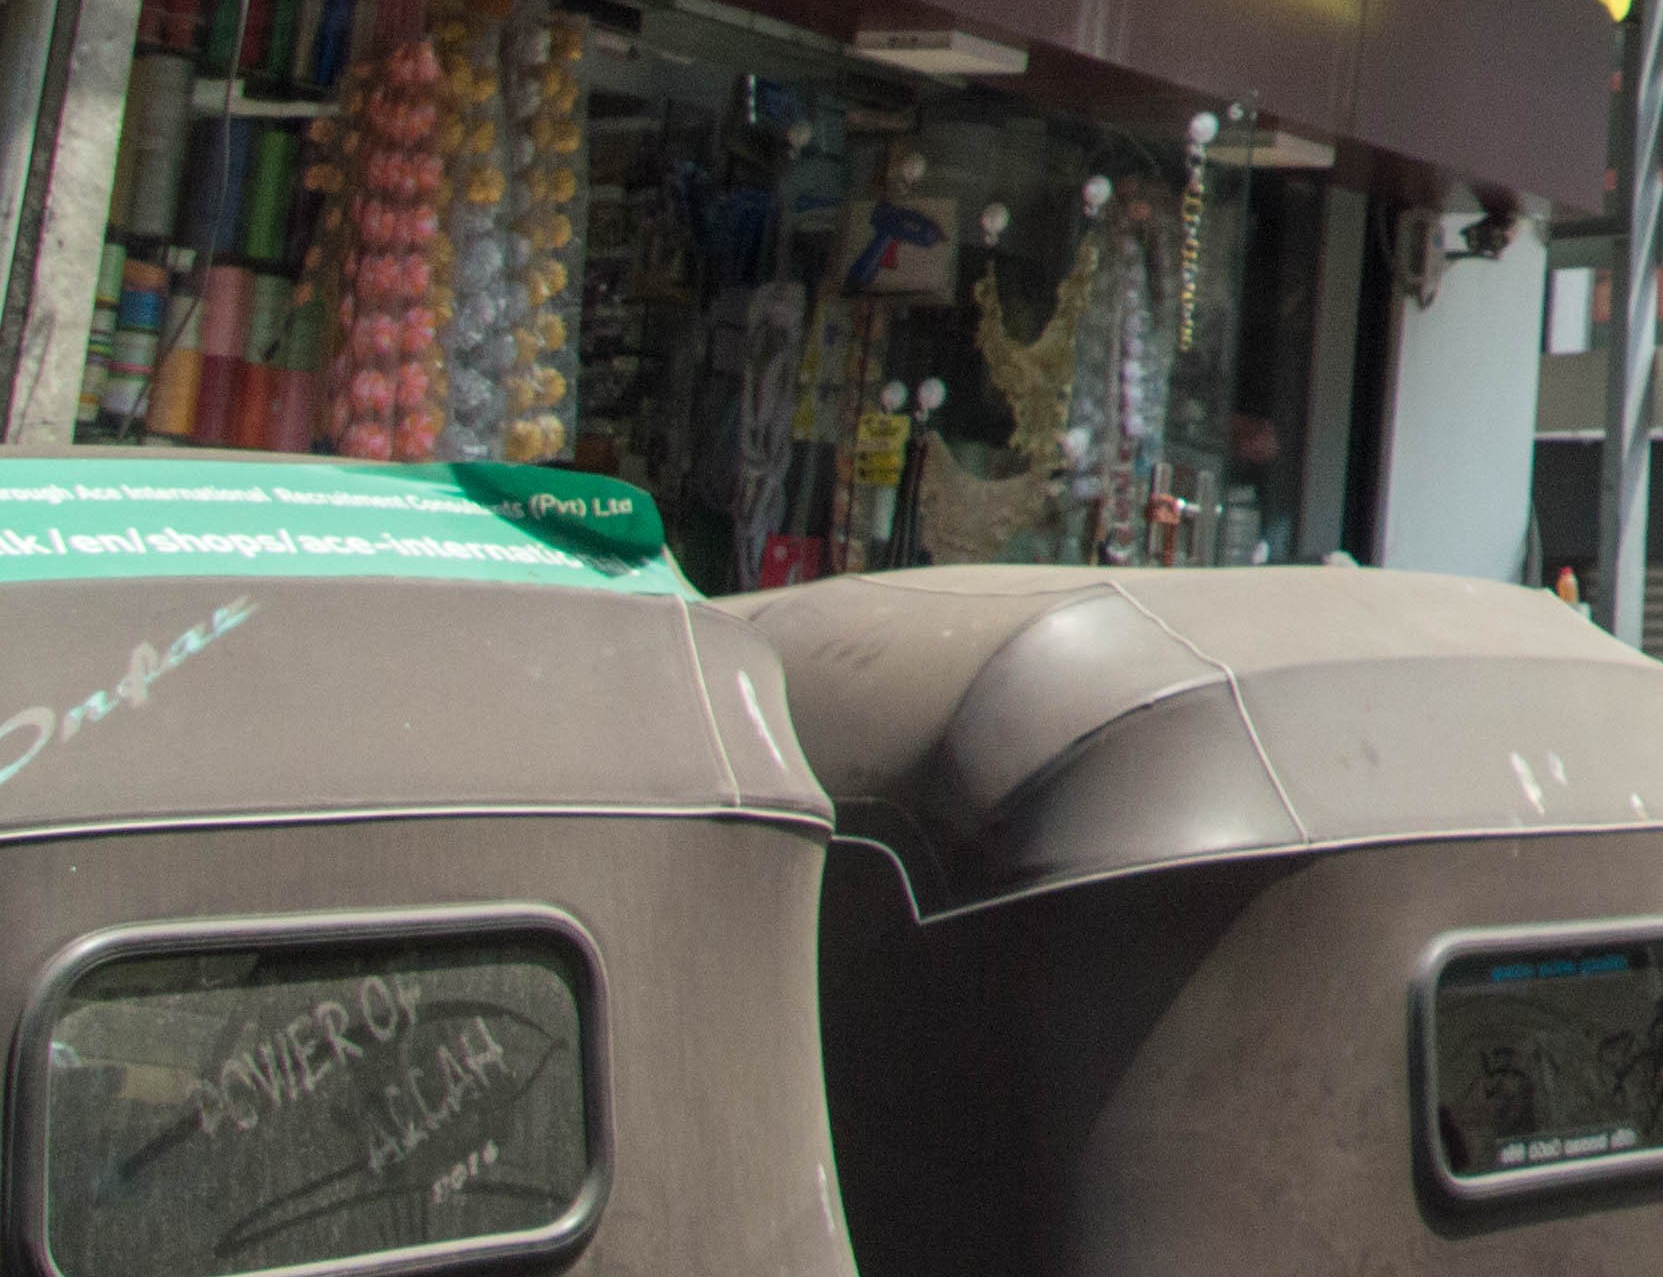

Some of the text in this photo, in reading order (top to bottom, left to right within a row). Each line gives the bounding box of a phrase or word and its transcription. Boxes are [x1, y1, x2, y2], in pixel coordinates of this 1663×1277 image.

[119, 484, 273, 503] International
[527, 492, 587, 519] (Pvt)
[591, 496, 633, 517] Ltd
